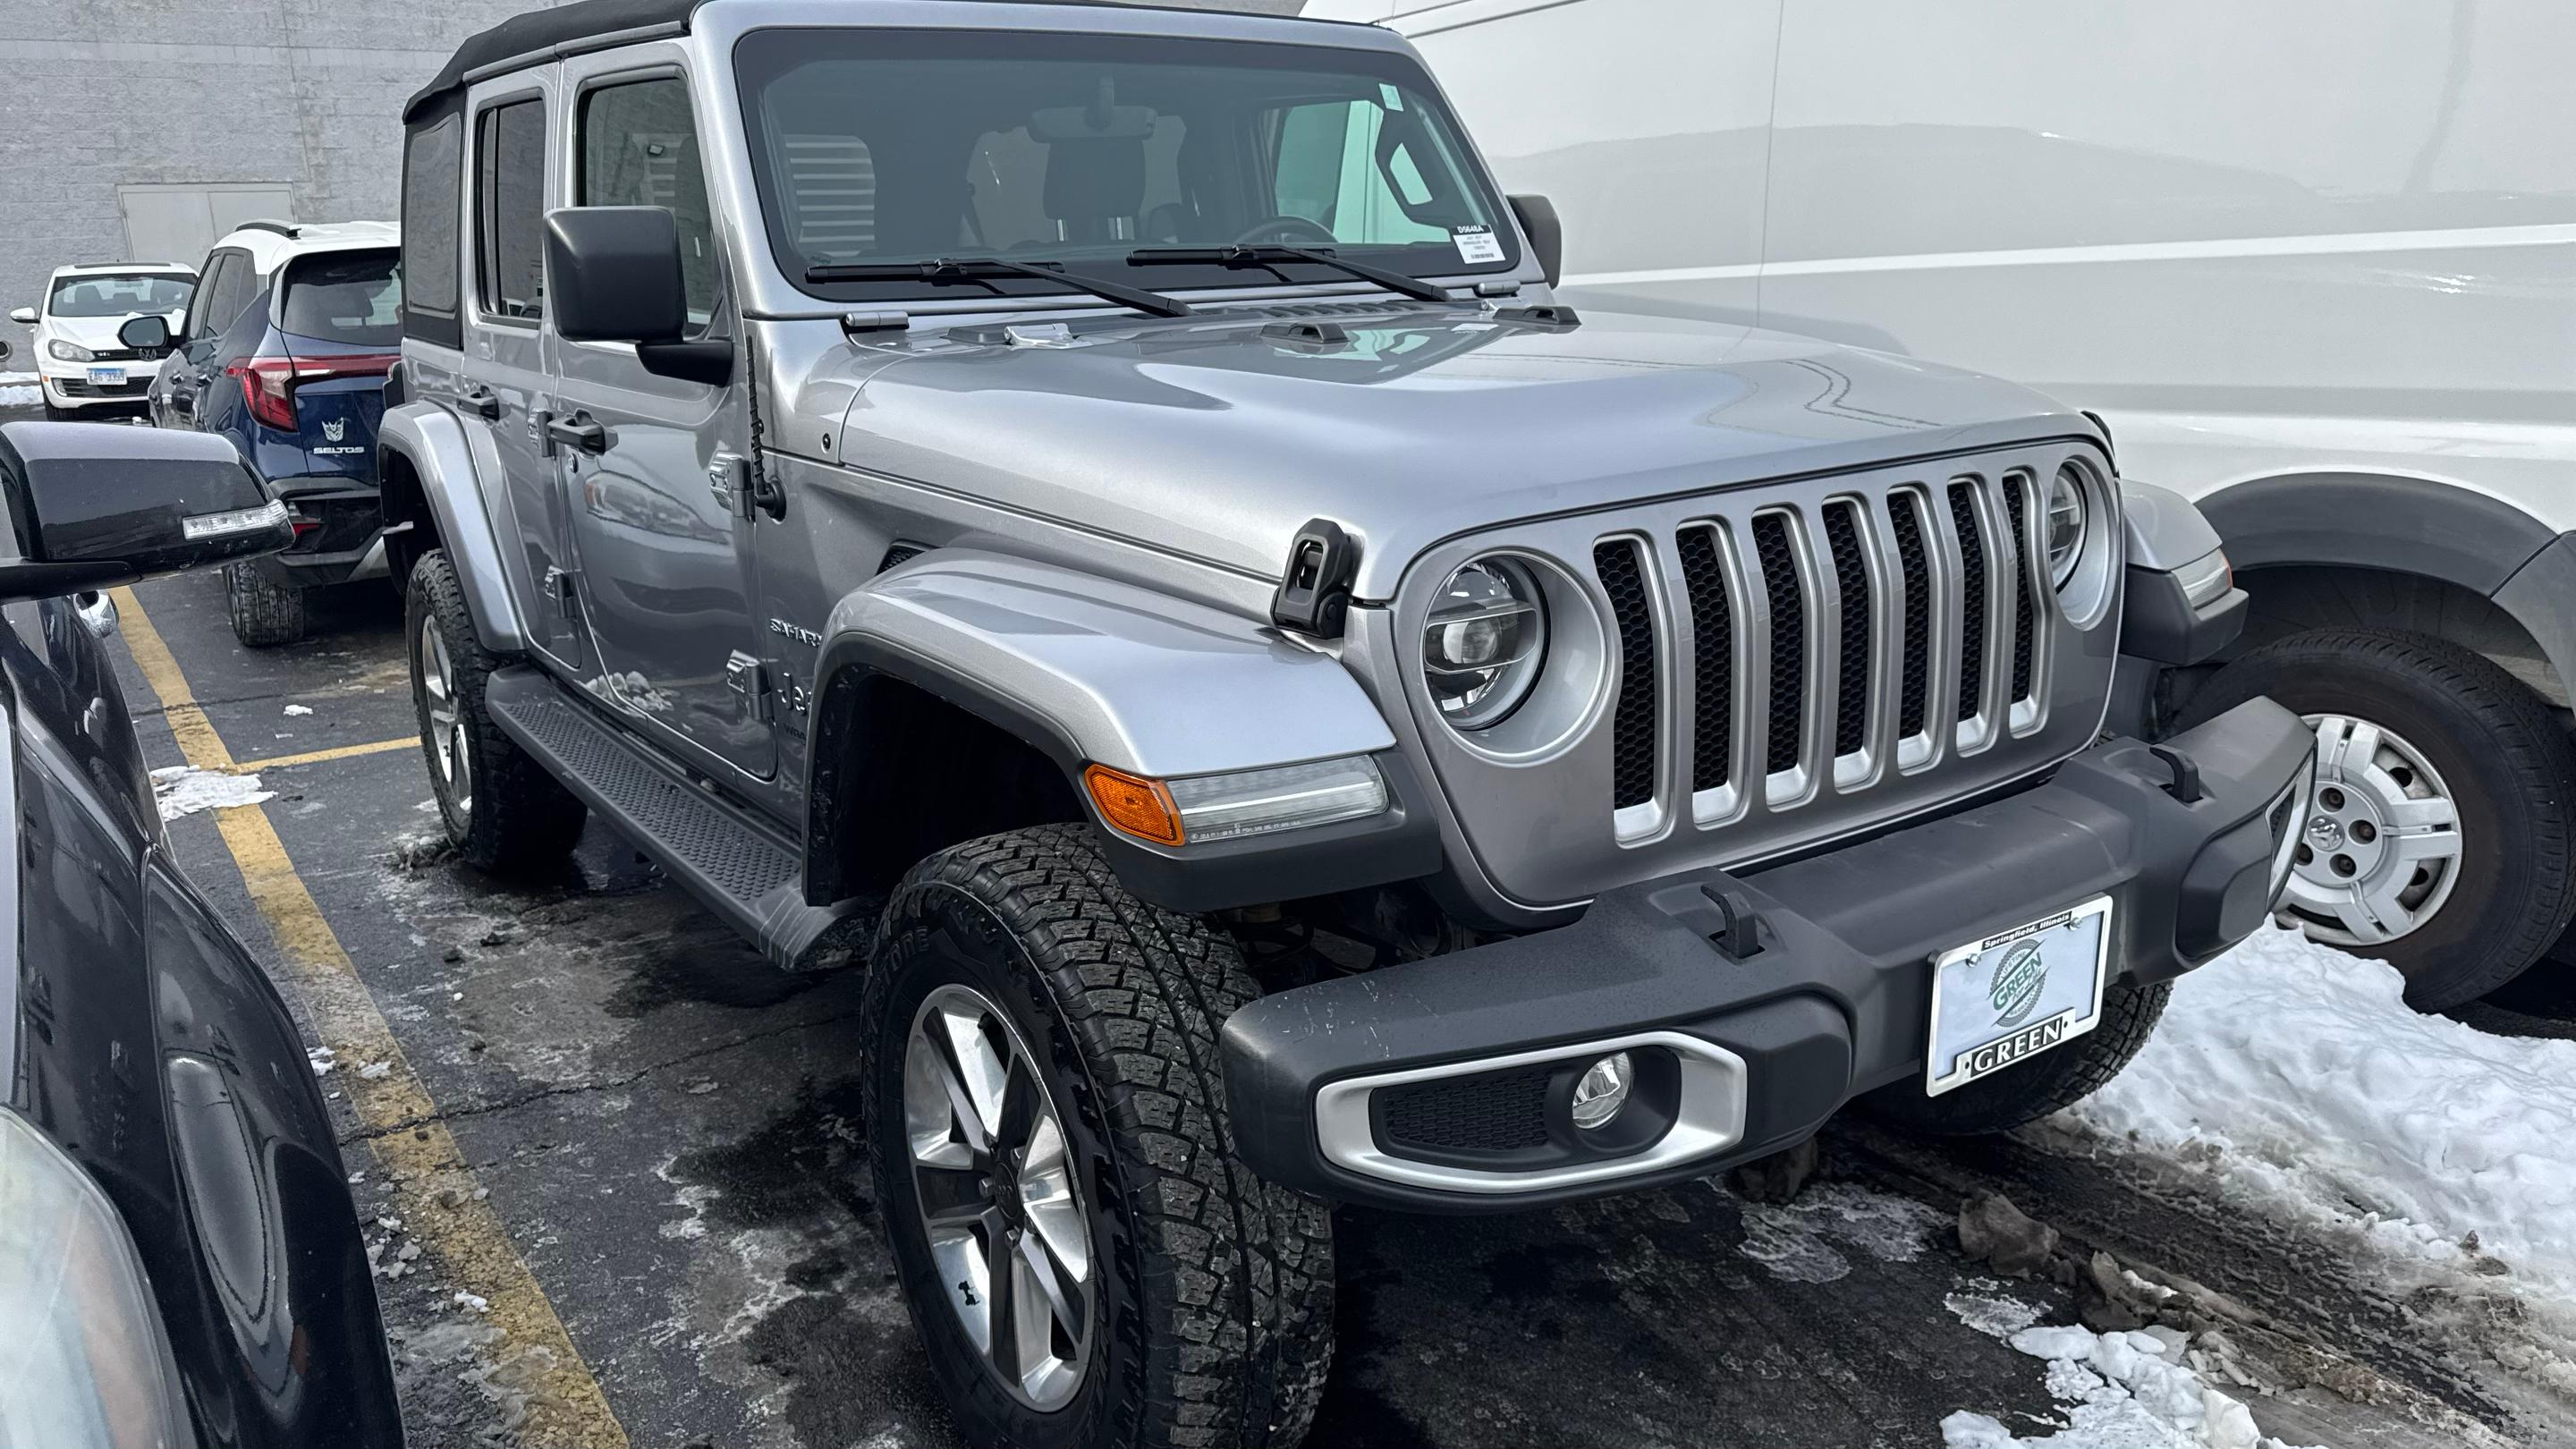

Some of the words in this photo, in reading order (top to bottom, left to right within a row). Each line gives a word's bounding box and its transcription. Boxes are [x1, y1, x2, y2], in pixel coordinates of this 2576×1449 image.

[313, 446, 365, 454] SELTOS
[777, 672, 812, 716] Je
[1984, 926, 2038, 948] Springfield,
[2039, 913, 2070, 930] Illinois
[1993, 951, 2043, 1011] GREEN
[1974, 1020, 2061, 1072] GREEN
